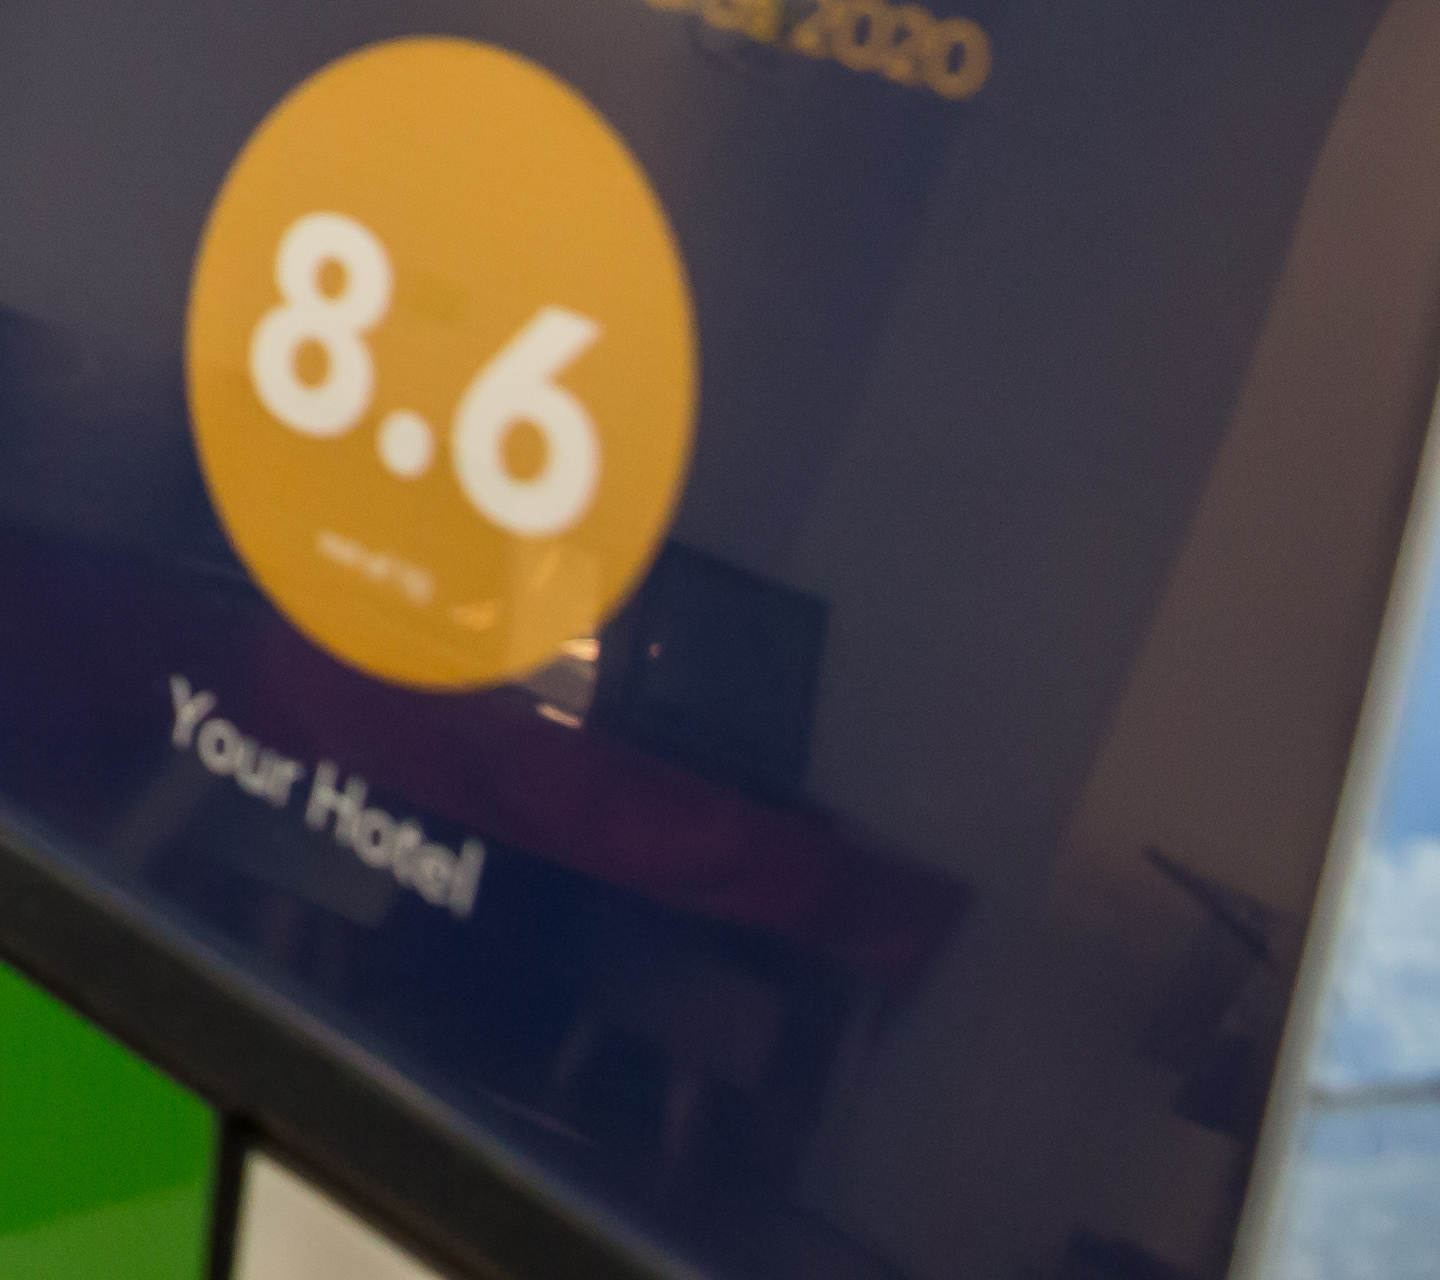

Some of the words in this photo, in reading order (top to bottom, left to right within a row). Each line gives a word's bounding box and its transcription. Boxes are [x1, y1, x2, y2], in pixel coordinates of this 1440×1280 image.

[248, 210, 604, 537] 8.6
[168, 673, 305, 808] Your
[302, 759, 486, 918] Hotel
